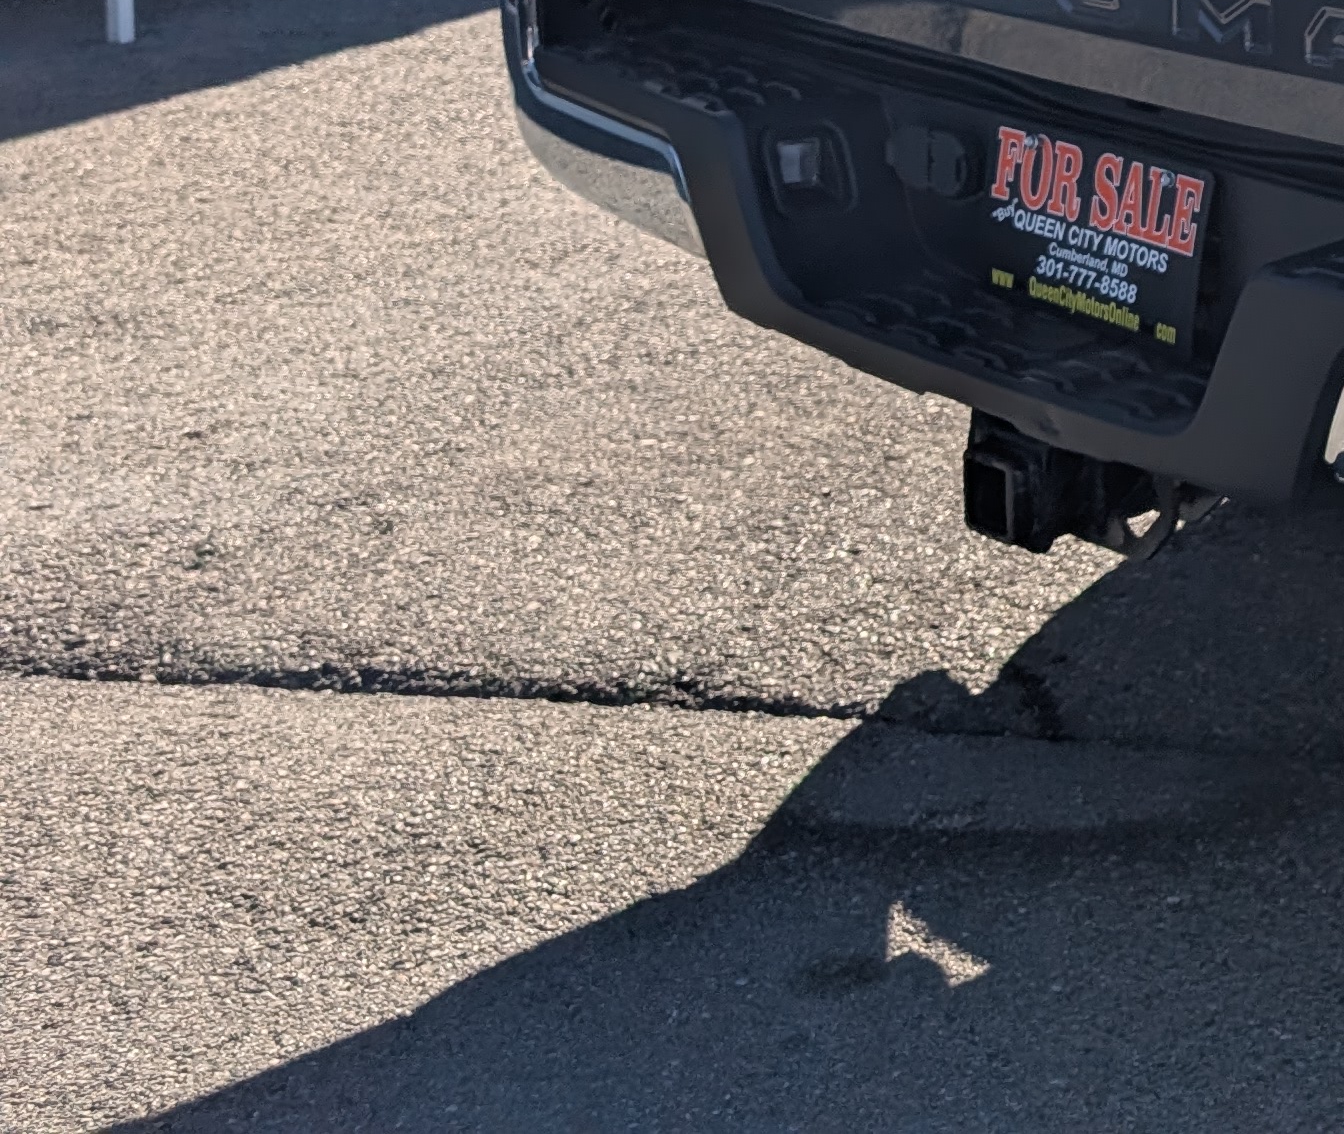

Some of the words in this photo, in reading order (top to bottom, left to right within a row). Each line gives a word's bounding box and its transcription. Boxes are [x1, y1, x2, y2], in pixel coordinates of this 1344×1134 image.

[991, 125, 1083, 222] FOR
[1089, 152, 1205, 257] SALE
[1014, 208, 1066, 242] QUEEN
[1068, 224, 1103, 251] CITY
[1104, 236, 1169, 273] MOTORS
[1049, 241, 1110, 273] Cumberland,
[1111, 261, 1129, 278] MD
[1036, 254, 1138, 304] 301-777-8588
